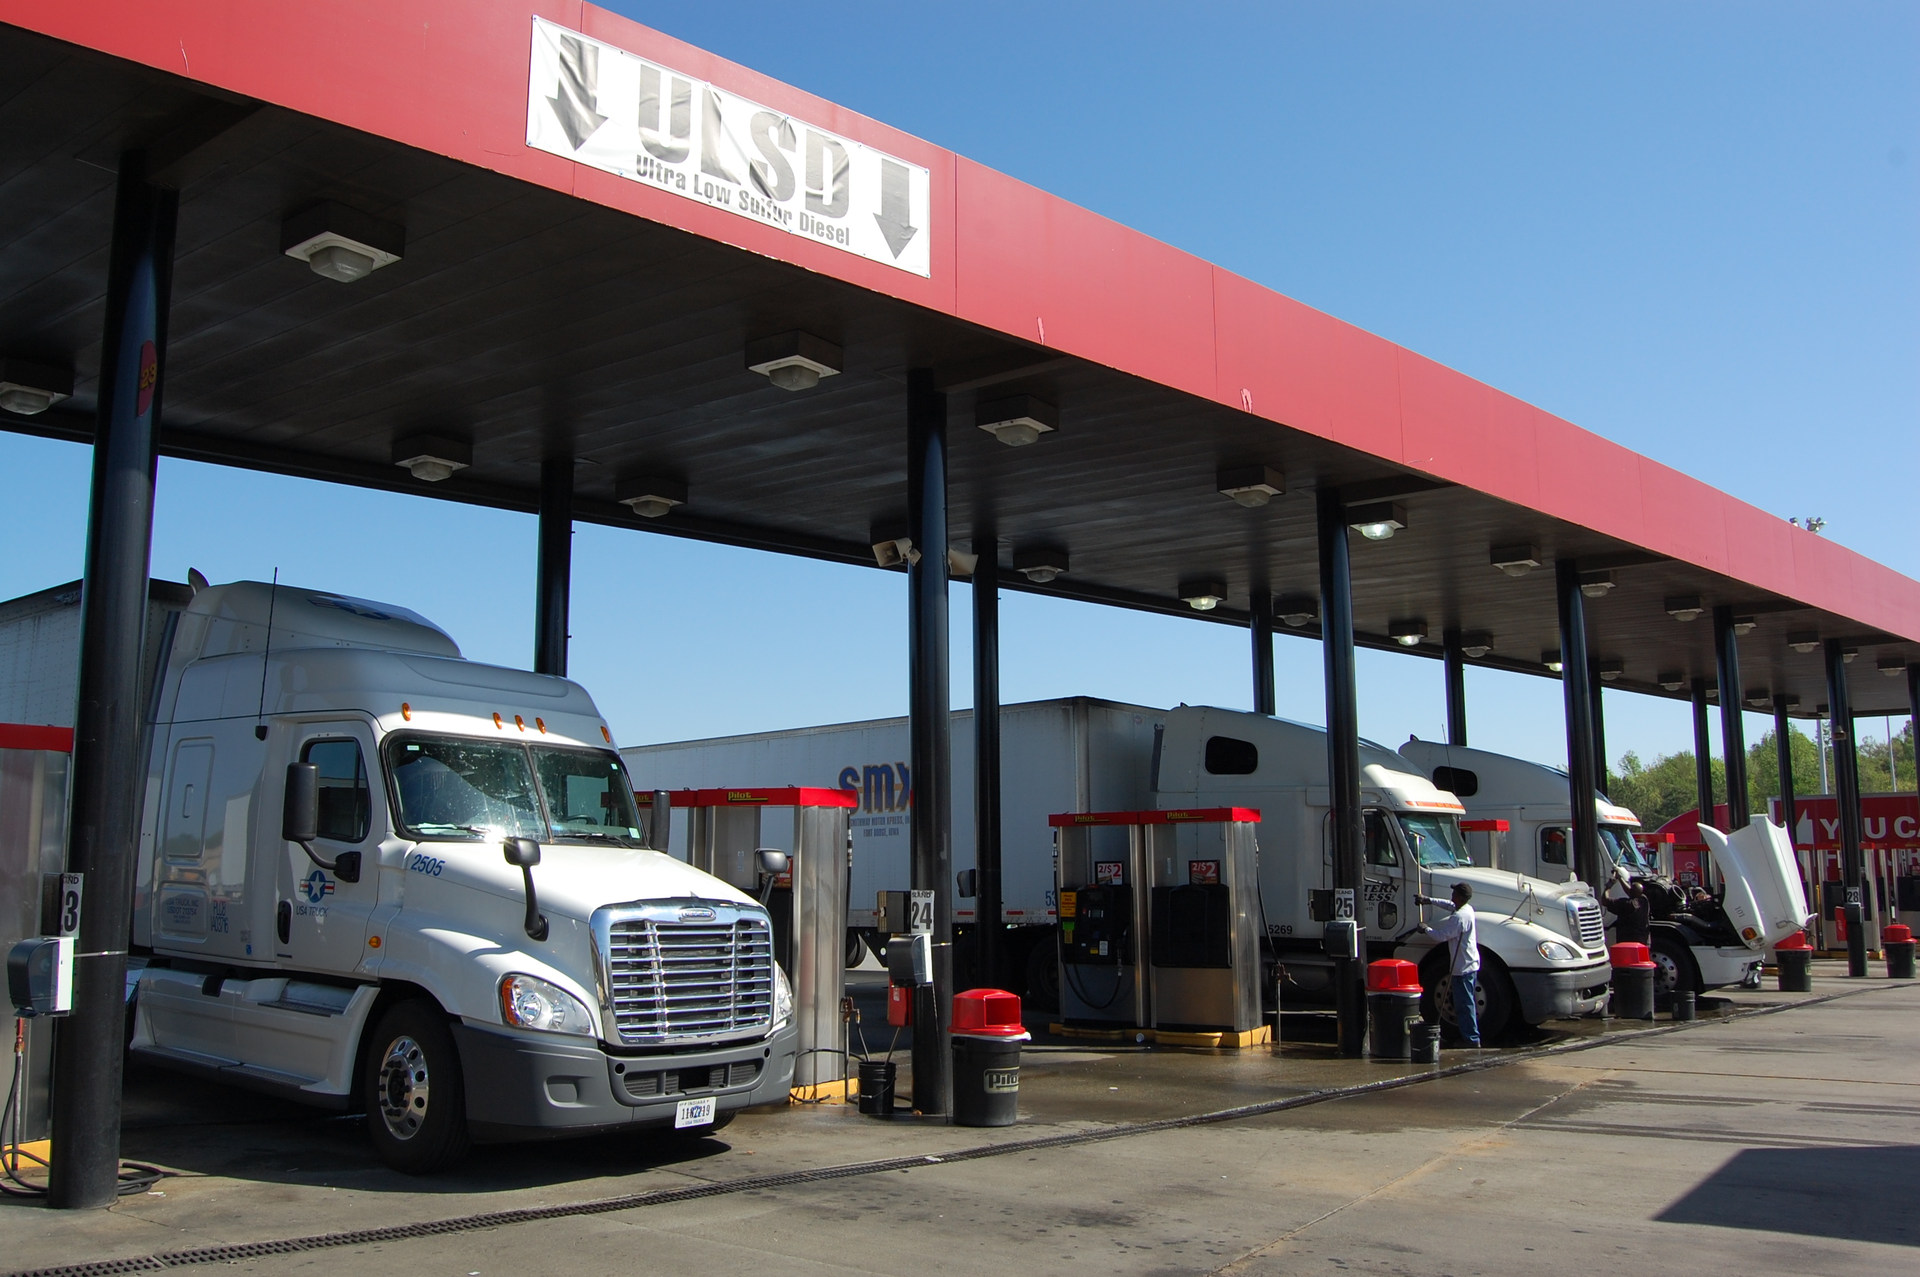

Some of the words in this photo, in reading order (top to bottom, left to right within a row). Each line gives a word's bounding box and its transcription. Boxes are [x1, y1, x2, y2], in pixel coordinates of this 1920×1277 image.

[638, 64, 850, 218] ULSD
[636, 154, 686, 191] Ultra
[694, 174, 731, 205] Low
[739, 190, 793, 226] Sulfur
[800, 211, 850, 246] Diesel
[1820, 816, 1887, 839] YU
[410, 854, 446, 877] 2505
[1364, 884, 1400, 893] TERN
[1847, 891, 1859, 902] 28
[296, 905, 308, 916] USA
[308, 906, 329, 918] TRUCK
[911, 901, 933, 930] 24
[1335, 896, 1354, 919] 25
[1268, 924, 1293, 935] 5269
[988, 1073, 1019, 1088] Pilo
